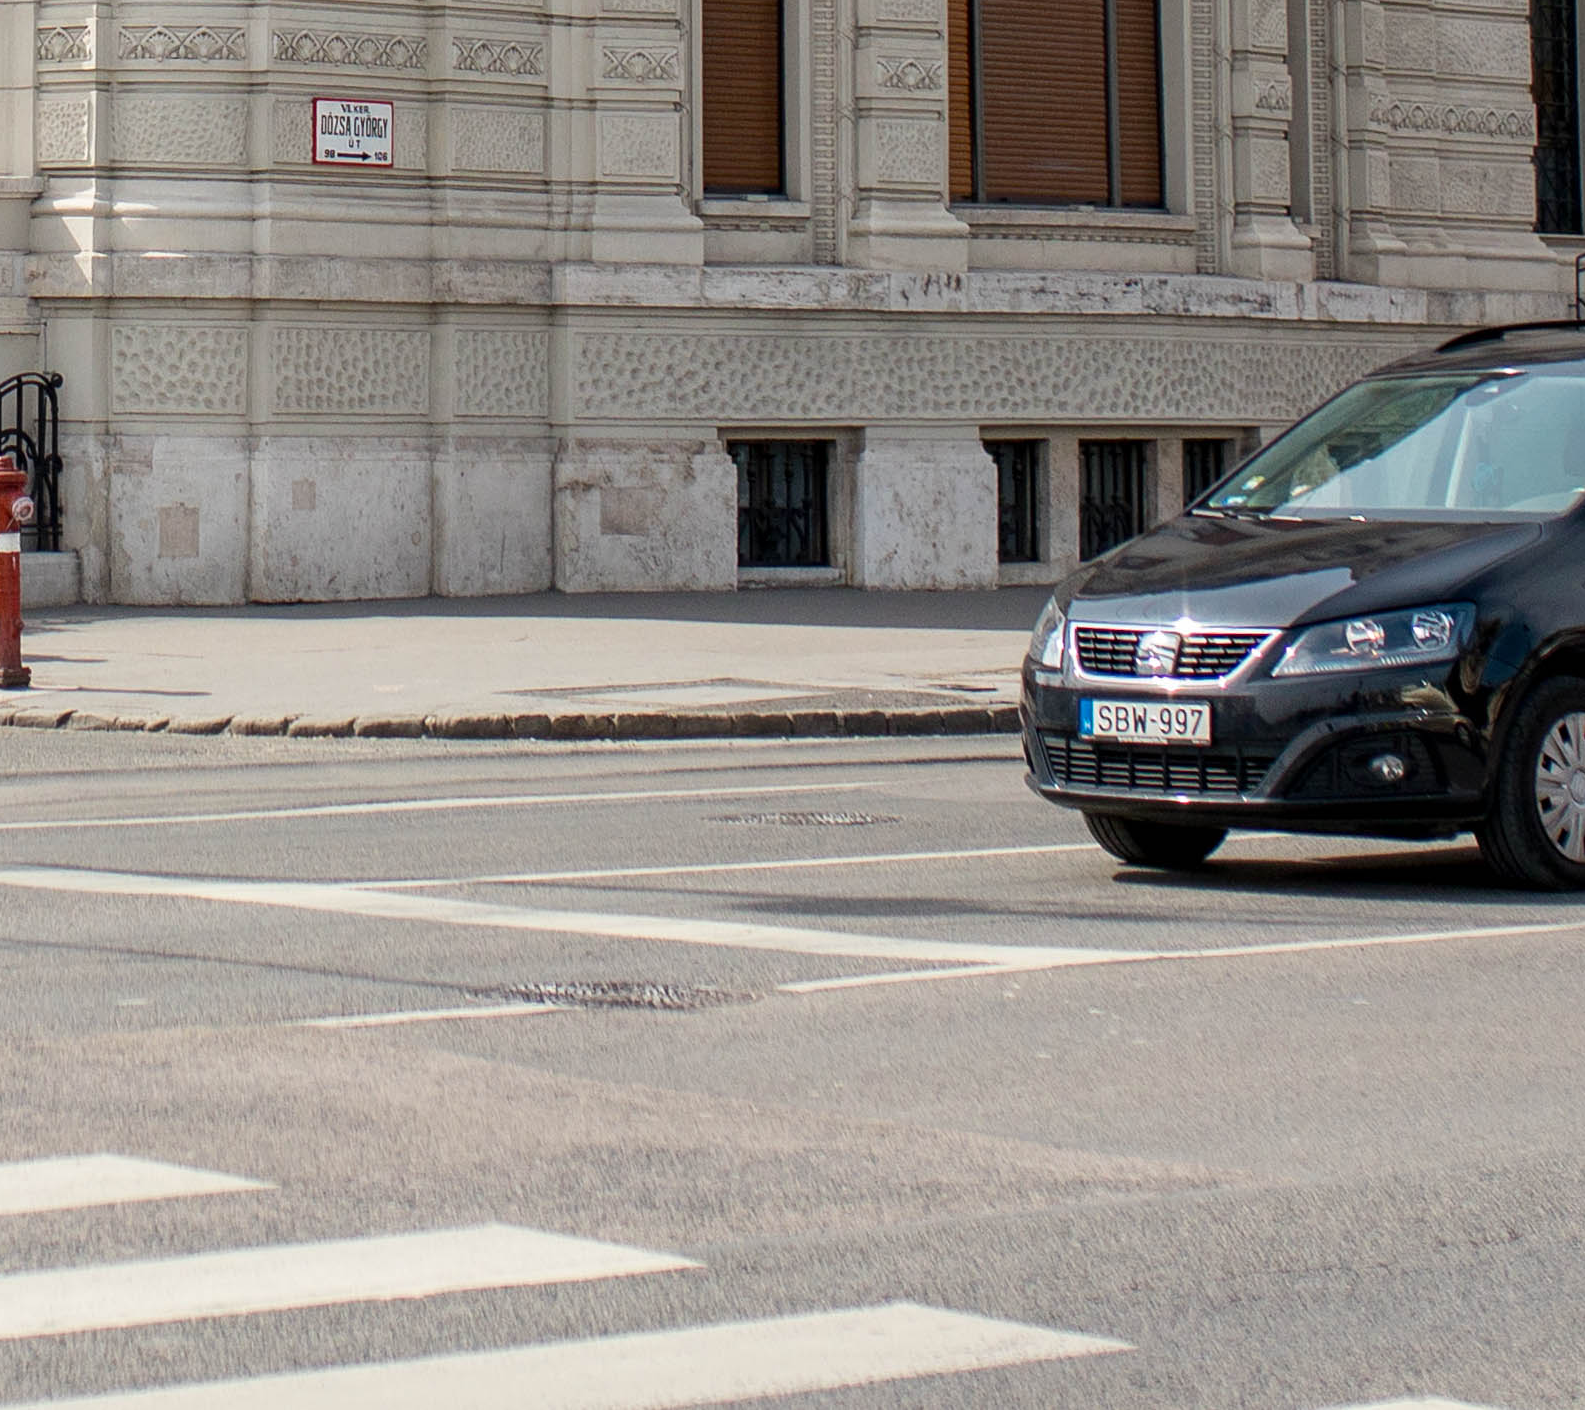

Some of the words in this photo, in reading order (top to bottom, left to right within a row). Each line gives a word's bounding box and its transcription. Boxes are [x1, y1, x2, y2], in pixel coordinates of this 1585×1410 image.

[321, 111, 351, 137] DÓZSA
[354, 115, 388, 139] GYÖRGY
[324, 149, 335, 158] 98
[374, 151, 388, 161] 106
[1097, 704, 1204, 737] SBW-997
